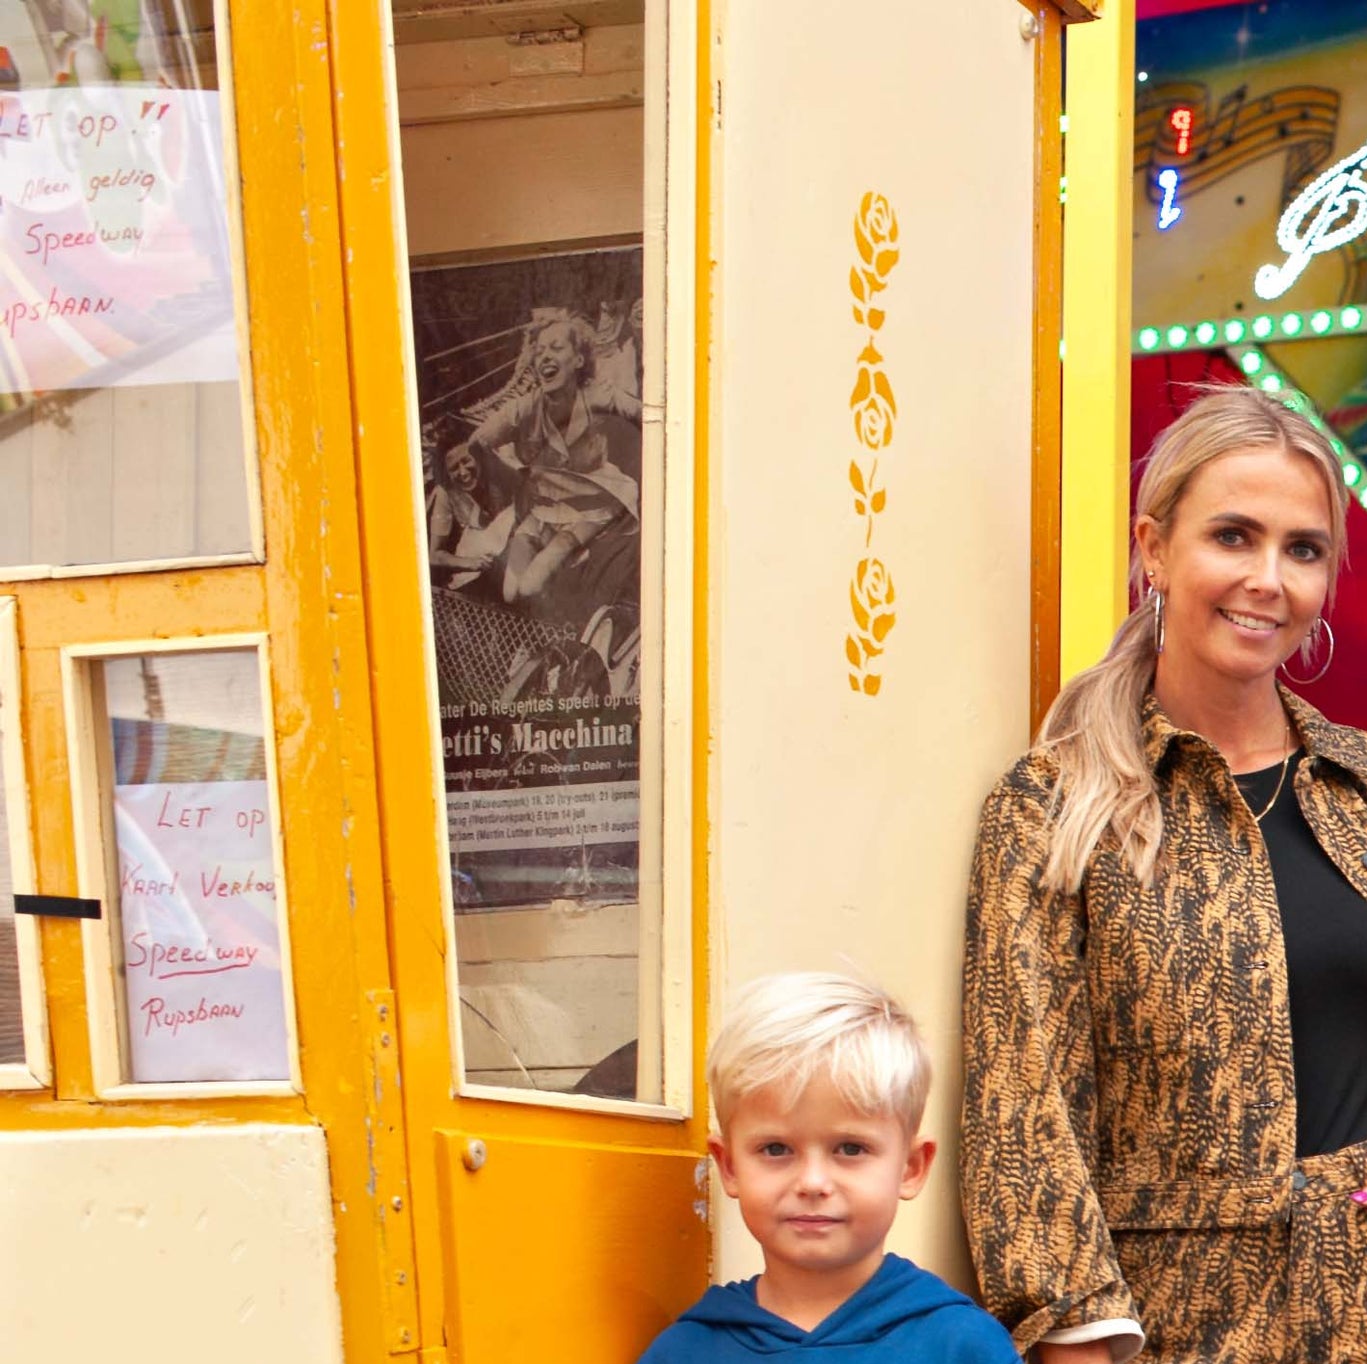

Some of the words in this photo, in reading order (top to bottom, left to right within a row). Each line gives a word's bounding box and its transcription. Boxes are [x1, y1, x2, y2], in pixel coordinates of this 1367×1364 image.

[87, 168, 155, 202] geldig
[440, 702, 465, 719] ater
[470, 700, 487, 717] De
[492, 697, 554, 718] Regentes
[558, 694, 600, 715] speelt
[604, 694, 621, 710] op
[442, 724, 502, 758] etti's
[511, 717, 633, 753] Macchina
